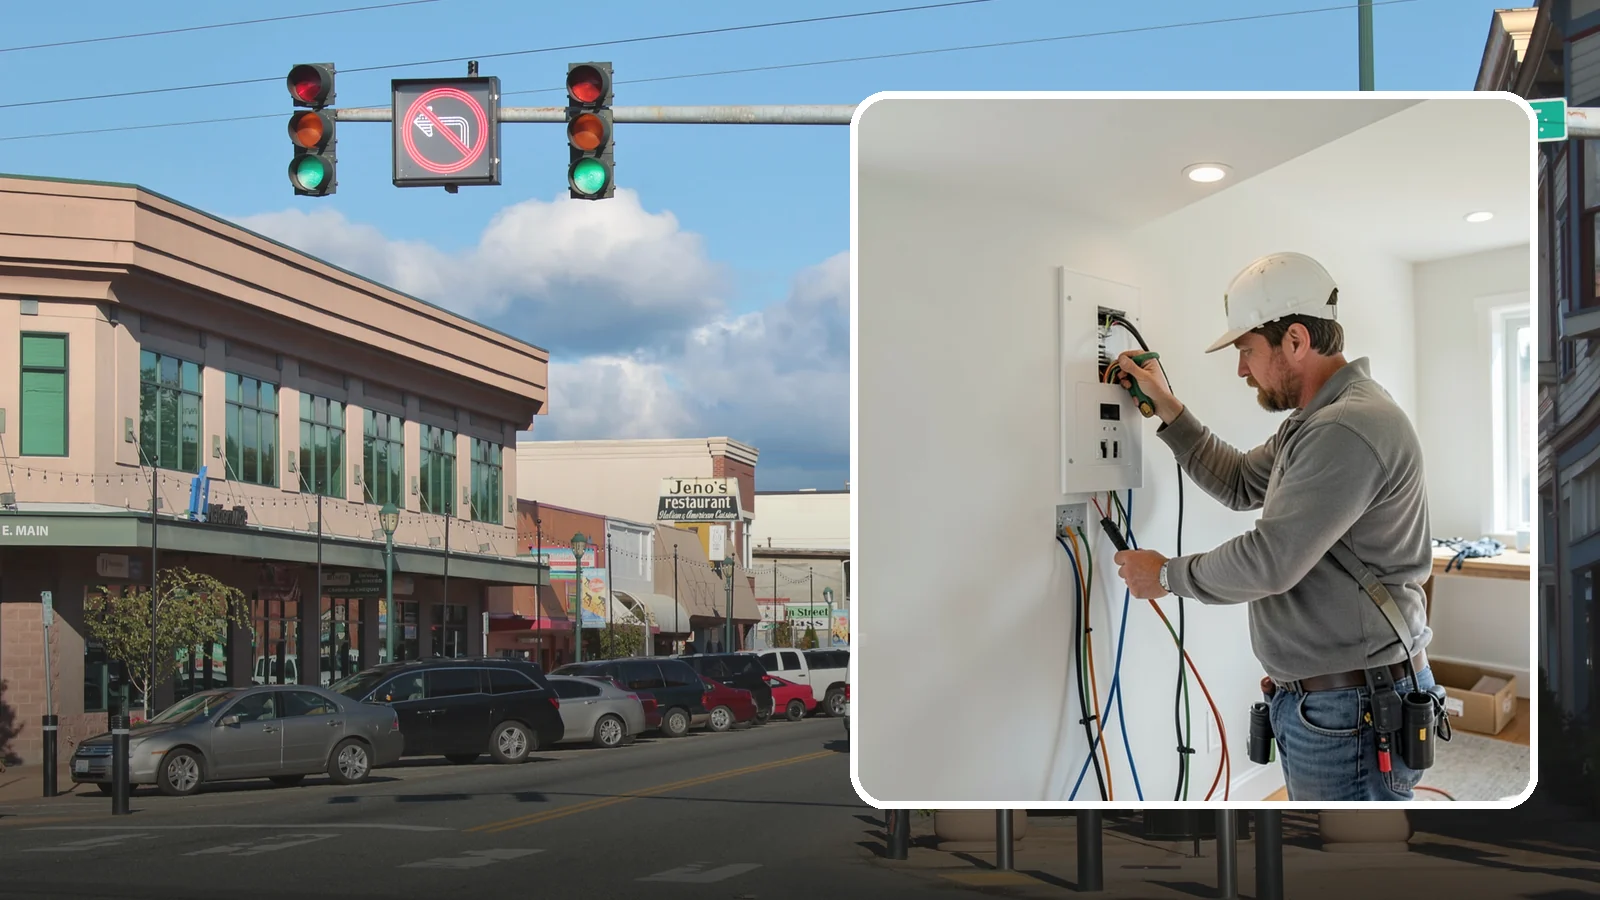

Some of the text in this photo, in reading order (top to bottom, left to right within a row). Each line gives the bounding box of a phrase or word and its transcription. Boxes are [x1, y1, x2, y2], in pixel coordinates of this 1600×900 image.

[669, 480, 727, 495] Jeno's
[665, 496, 731, 509] restaurant
[658, 510, 681, 519] Italian
[686, 510, 714, 519] American
[715, 509, 738, 519] Cuisine
[2, 525, 49, 536] E. MAIN
[797, 607, 828, 617] Street
